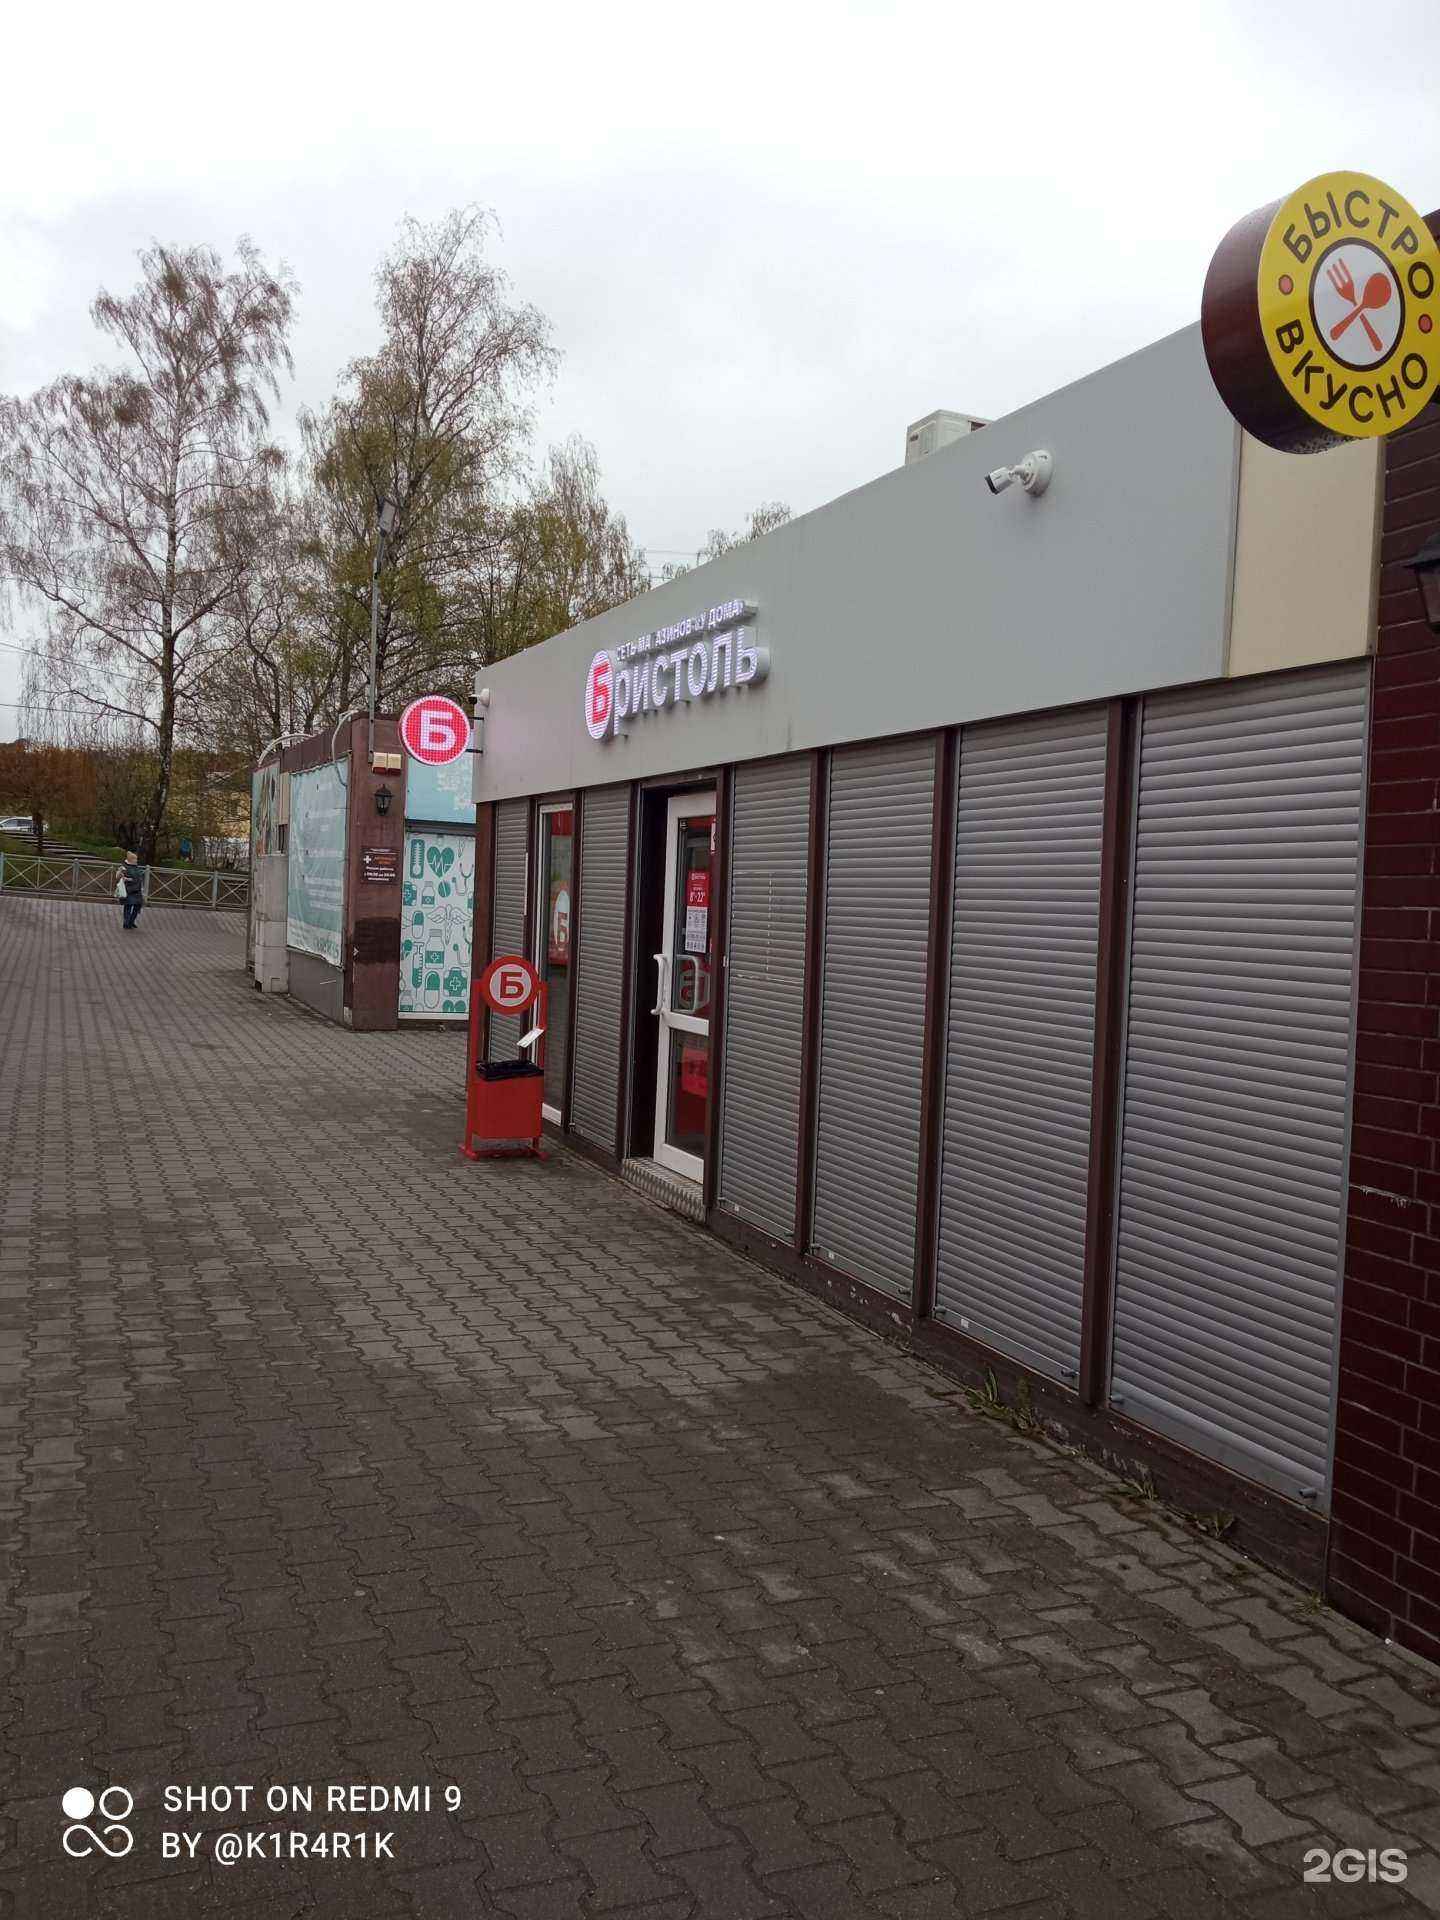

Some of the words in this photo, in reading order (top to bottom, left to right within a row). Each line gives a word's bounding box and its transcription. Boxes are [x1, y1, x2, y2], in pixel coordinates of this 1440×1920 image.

[1283, 190, 1434, 299] БЫСТРО
[1275, 318, 1428, 423] ВКУСНО
[420, 709, 456, 751] Б
[500, 971, 525, 1000] Б
